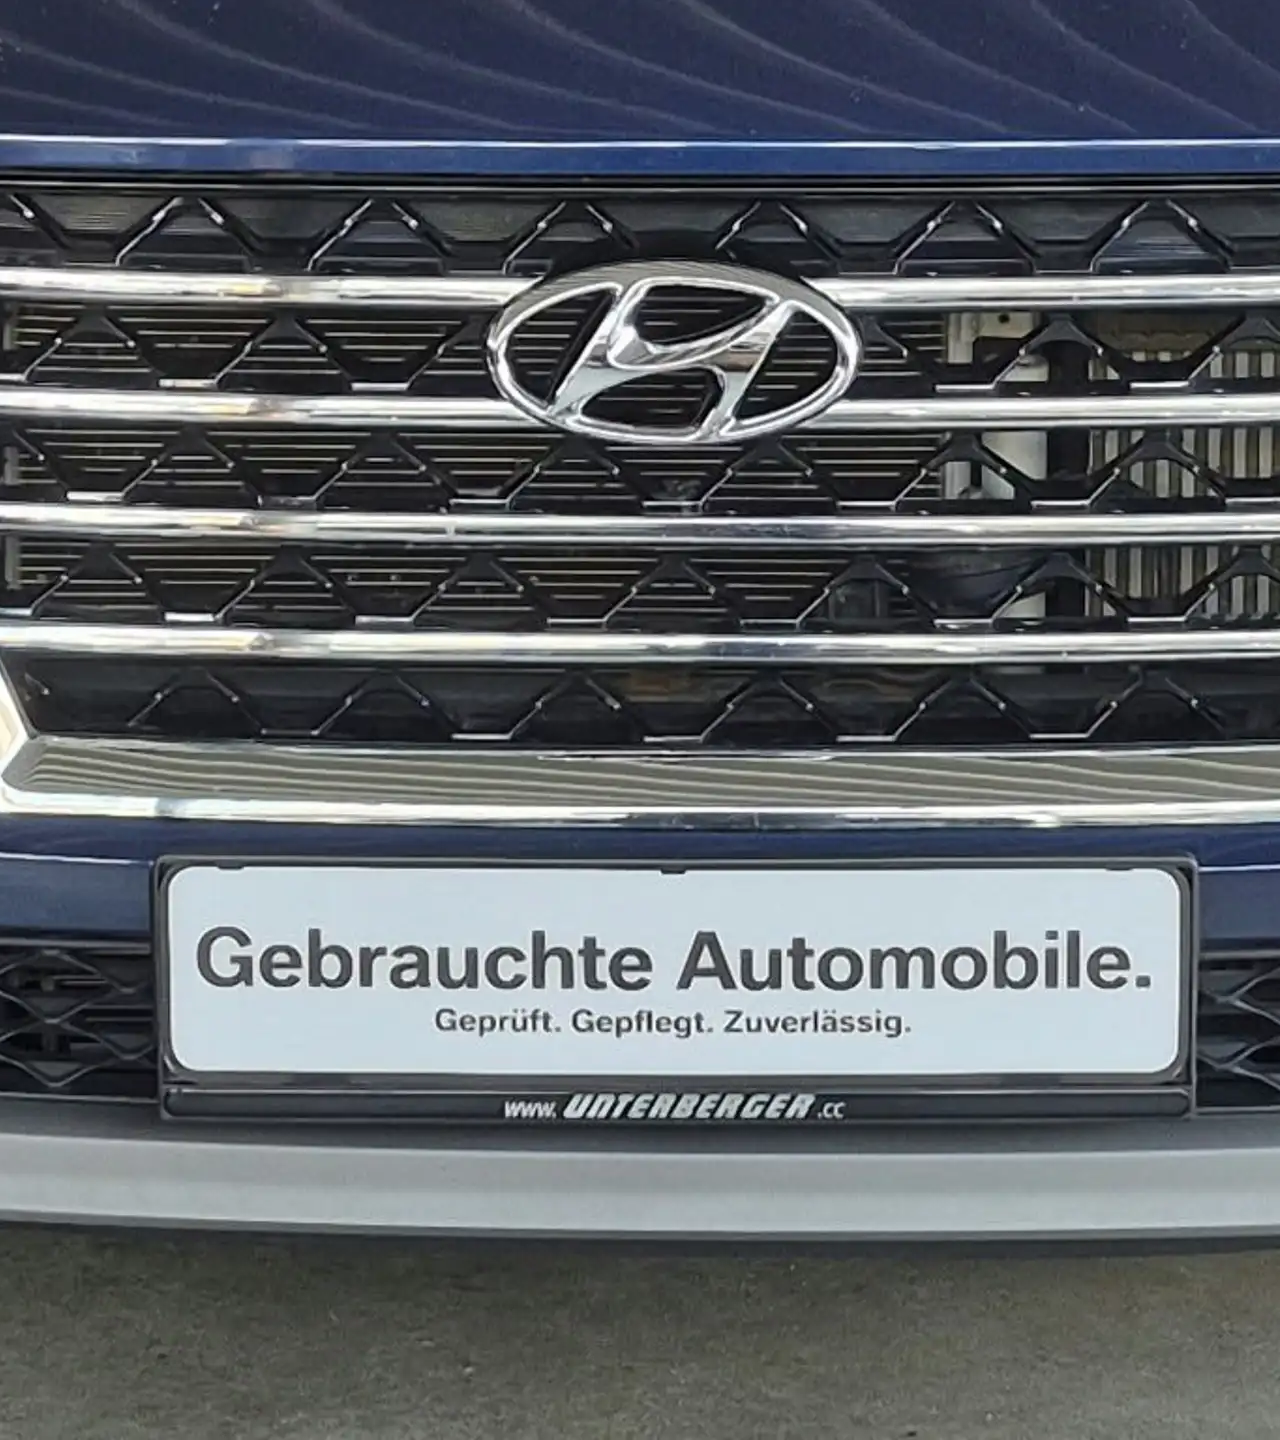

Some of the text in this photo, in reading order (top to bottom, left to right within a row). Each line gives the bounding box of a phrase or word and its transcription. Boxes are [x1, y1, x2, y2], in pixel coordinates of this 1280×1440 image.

[196, 926, 1152, 992] Gebrauchte Automobile.
[434, 1008, 912, 1039] Geprüft. Gepflegt. Zuverlässig.
